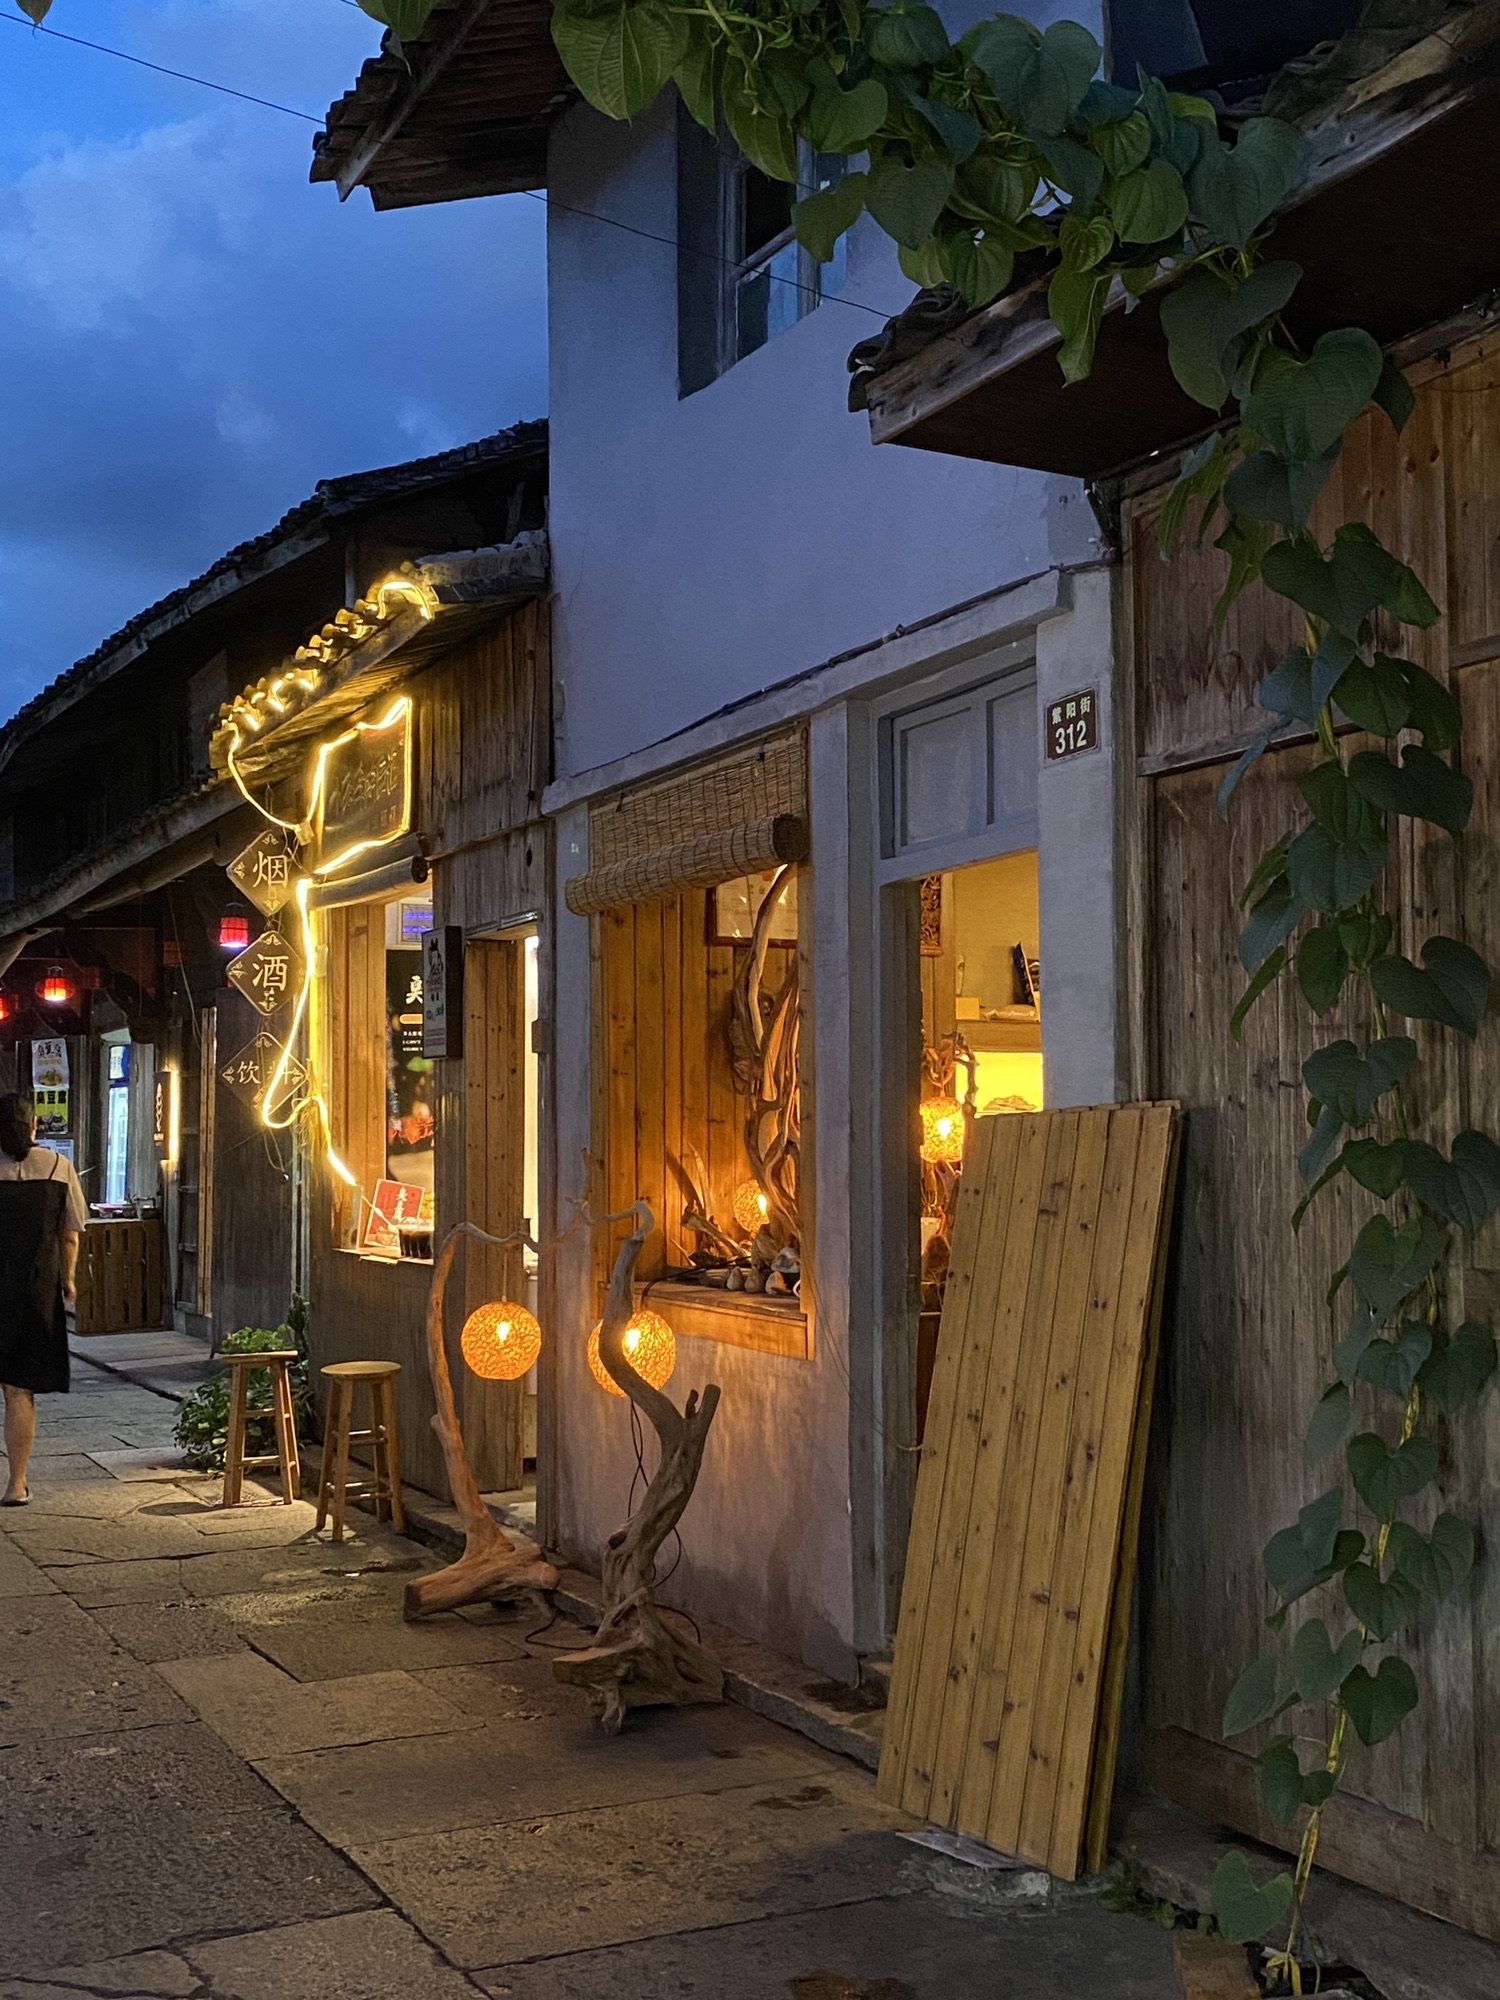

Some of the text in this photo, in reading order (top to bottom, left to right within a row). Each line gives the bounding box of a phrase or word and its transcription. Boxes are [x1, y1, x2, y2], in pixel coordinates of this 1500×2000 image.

[1051, 696, 1091, 725] 紫阳街
[1055, 720, 1087, 754] 312
[252, 850, 290, 889] 烟
[252, 953, 290, 991] 酒
